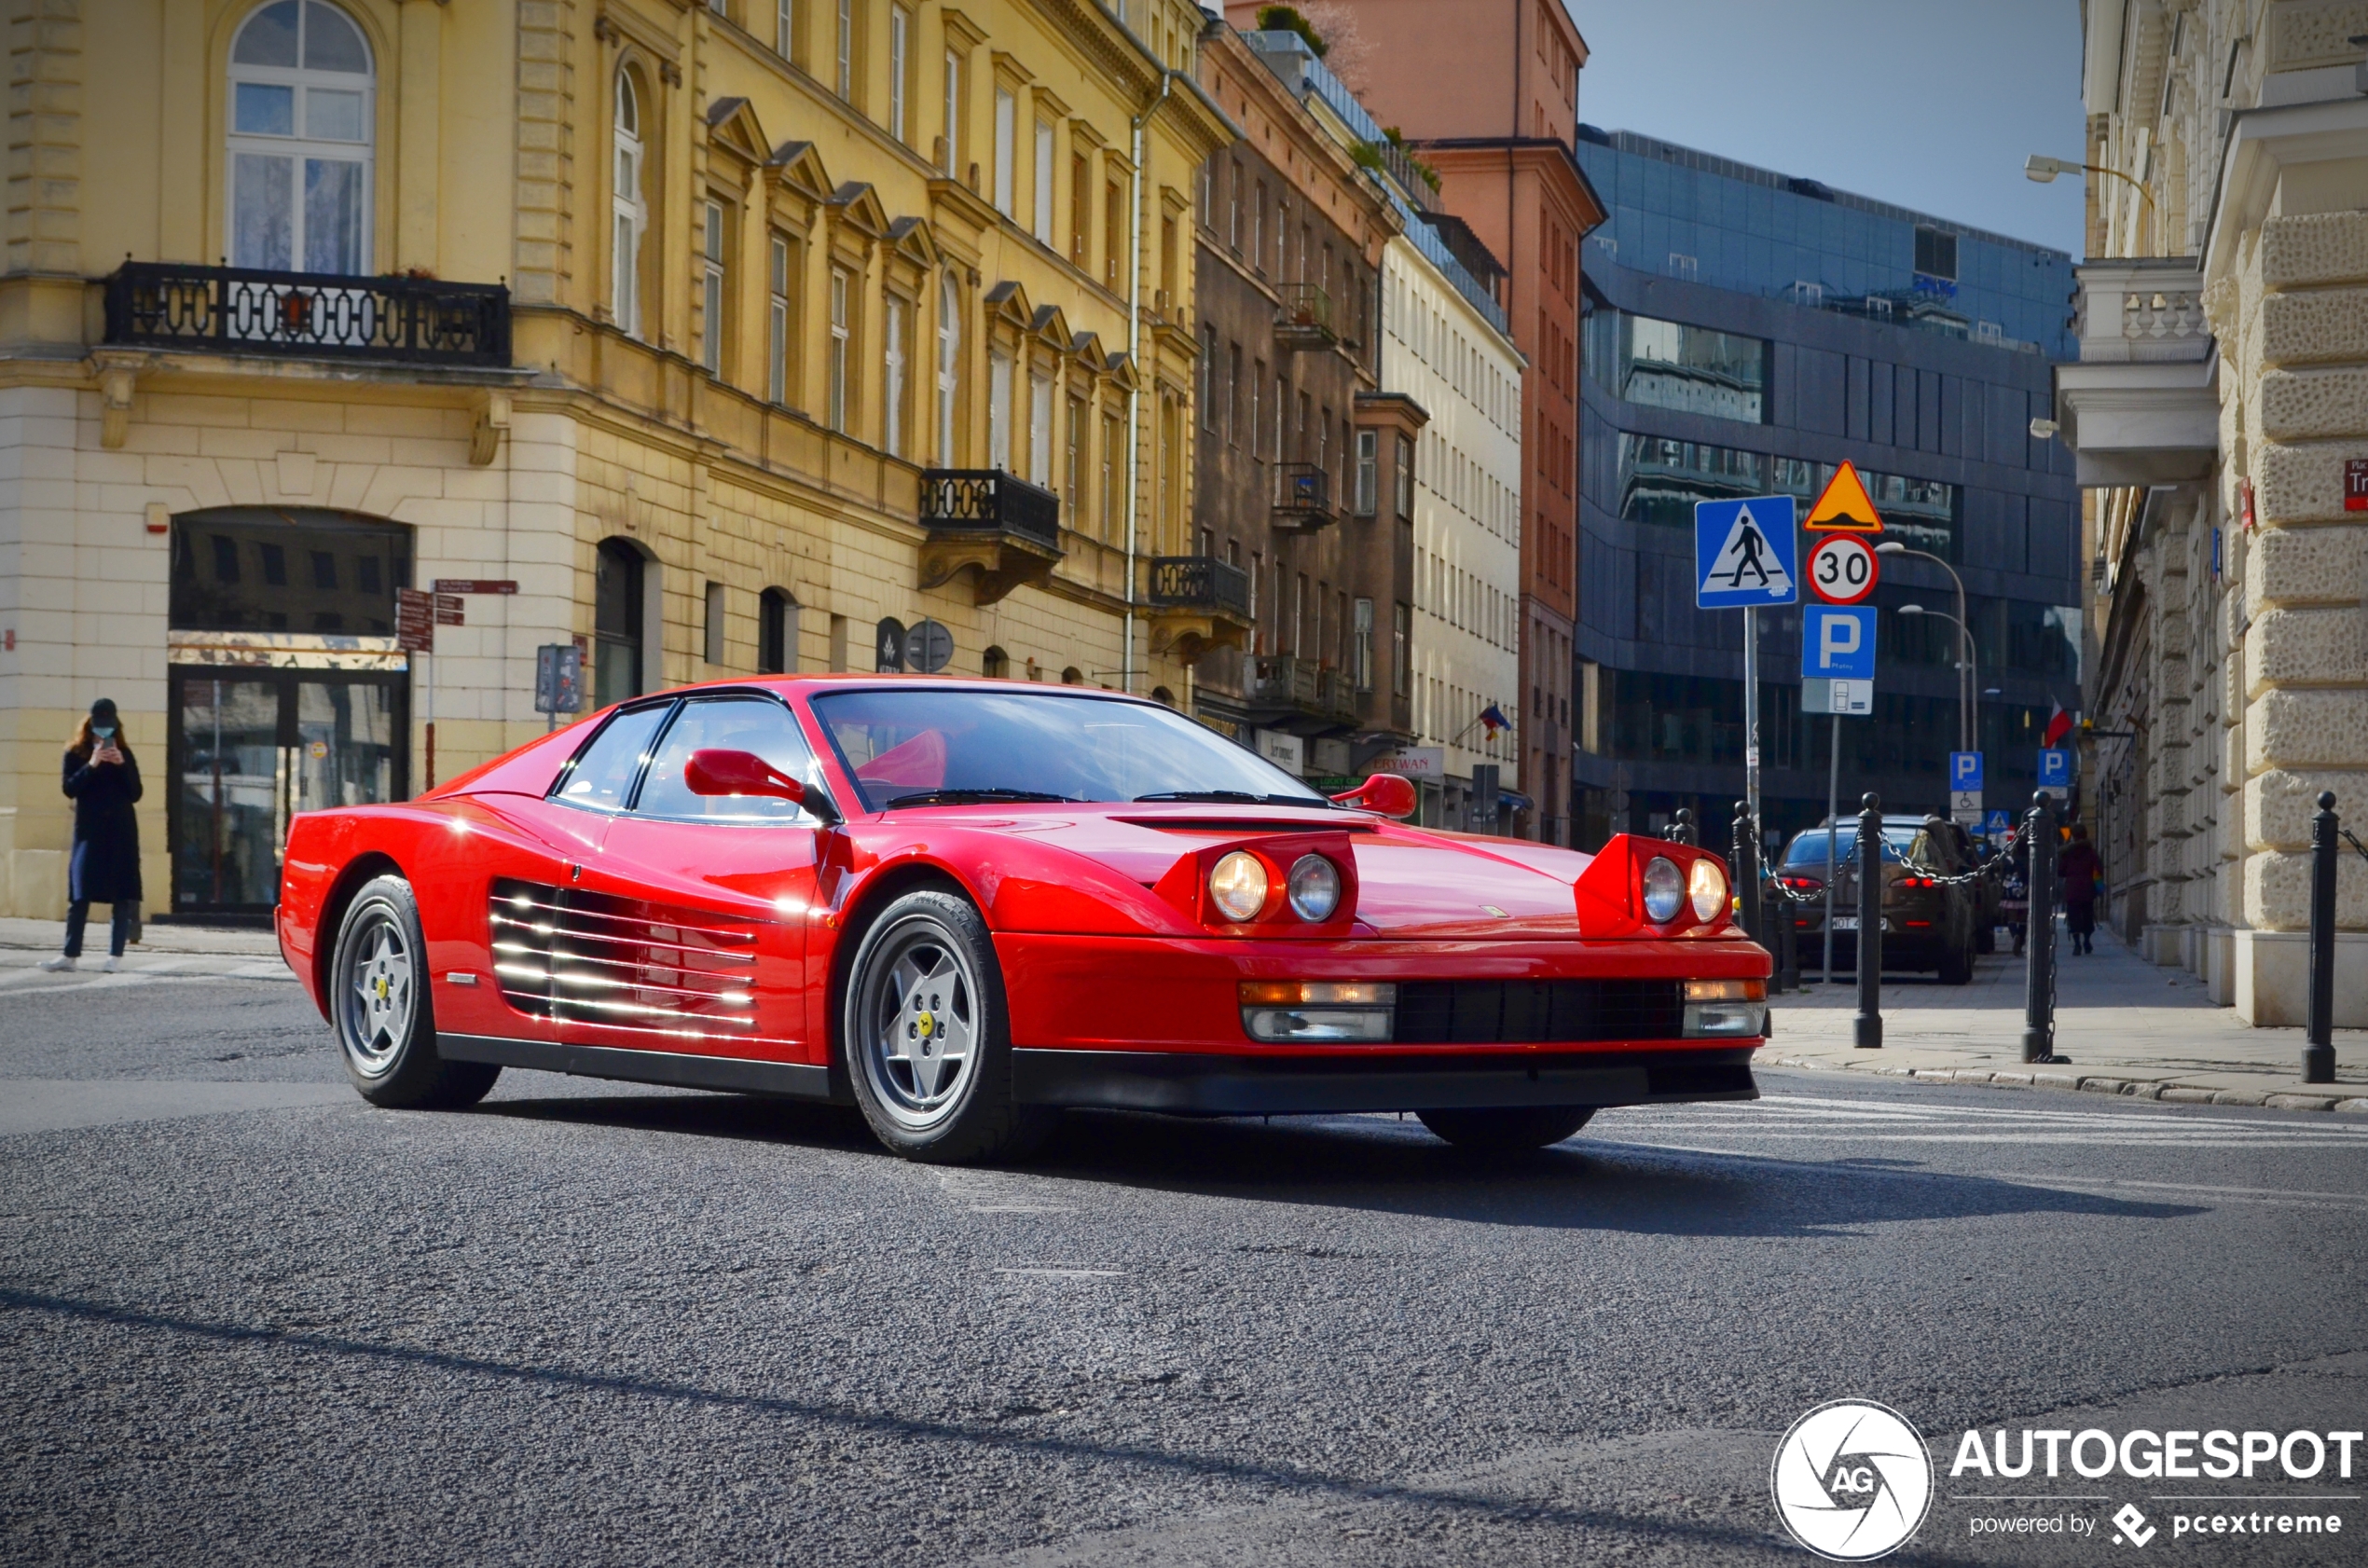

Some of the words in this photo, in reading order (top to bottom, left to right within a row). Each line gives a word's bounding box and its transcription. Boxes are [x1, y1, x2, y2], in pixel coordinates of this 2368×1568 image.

[2352, 461, 2368, 470] Plac
[1819, 552, 1867, 585] 30
[1820, 614, 1861, 668] P
[1373, 757, 1428, 769] ERYWAŃ
[1958, 755, 1976, 779] P
[2045, 752, 2062, 776] P
[914, 890, 985, 970] MICHELI
